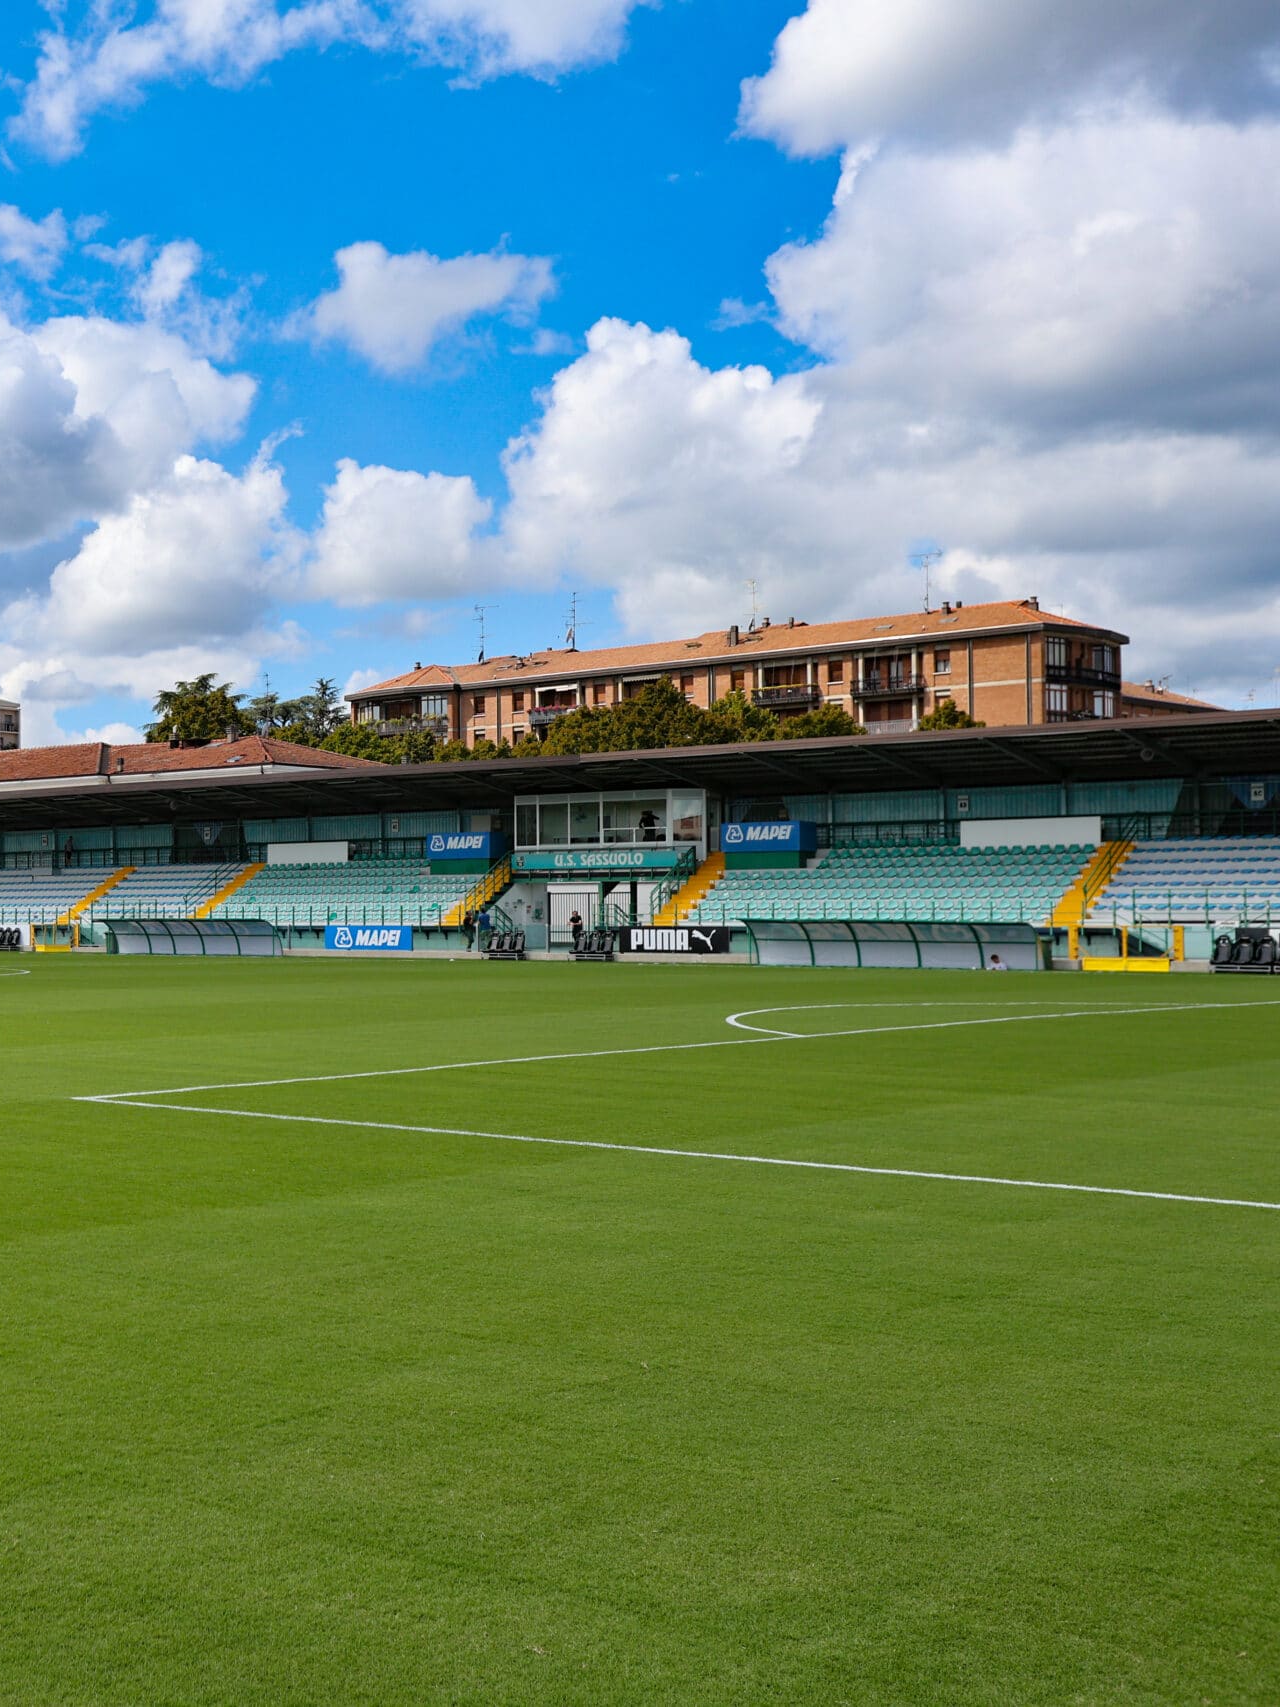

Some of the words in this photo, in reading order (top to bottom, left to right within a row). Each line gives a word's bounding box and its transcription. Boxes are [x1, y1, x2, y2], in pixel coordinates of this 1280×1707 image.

[746, 825, 792, 841] MAPEI
[446, 836, 483, 850] MAPEI
[554, 853, 577, 867] U.S.
[580, 852, 643, 866] SASSUOLO
[355, 929, 401, 947] MAPEI
[631, 929, 689, 951] PUMA
